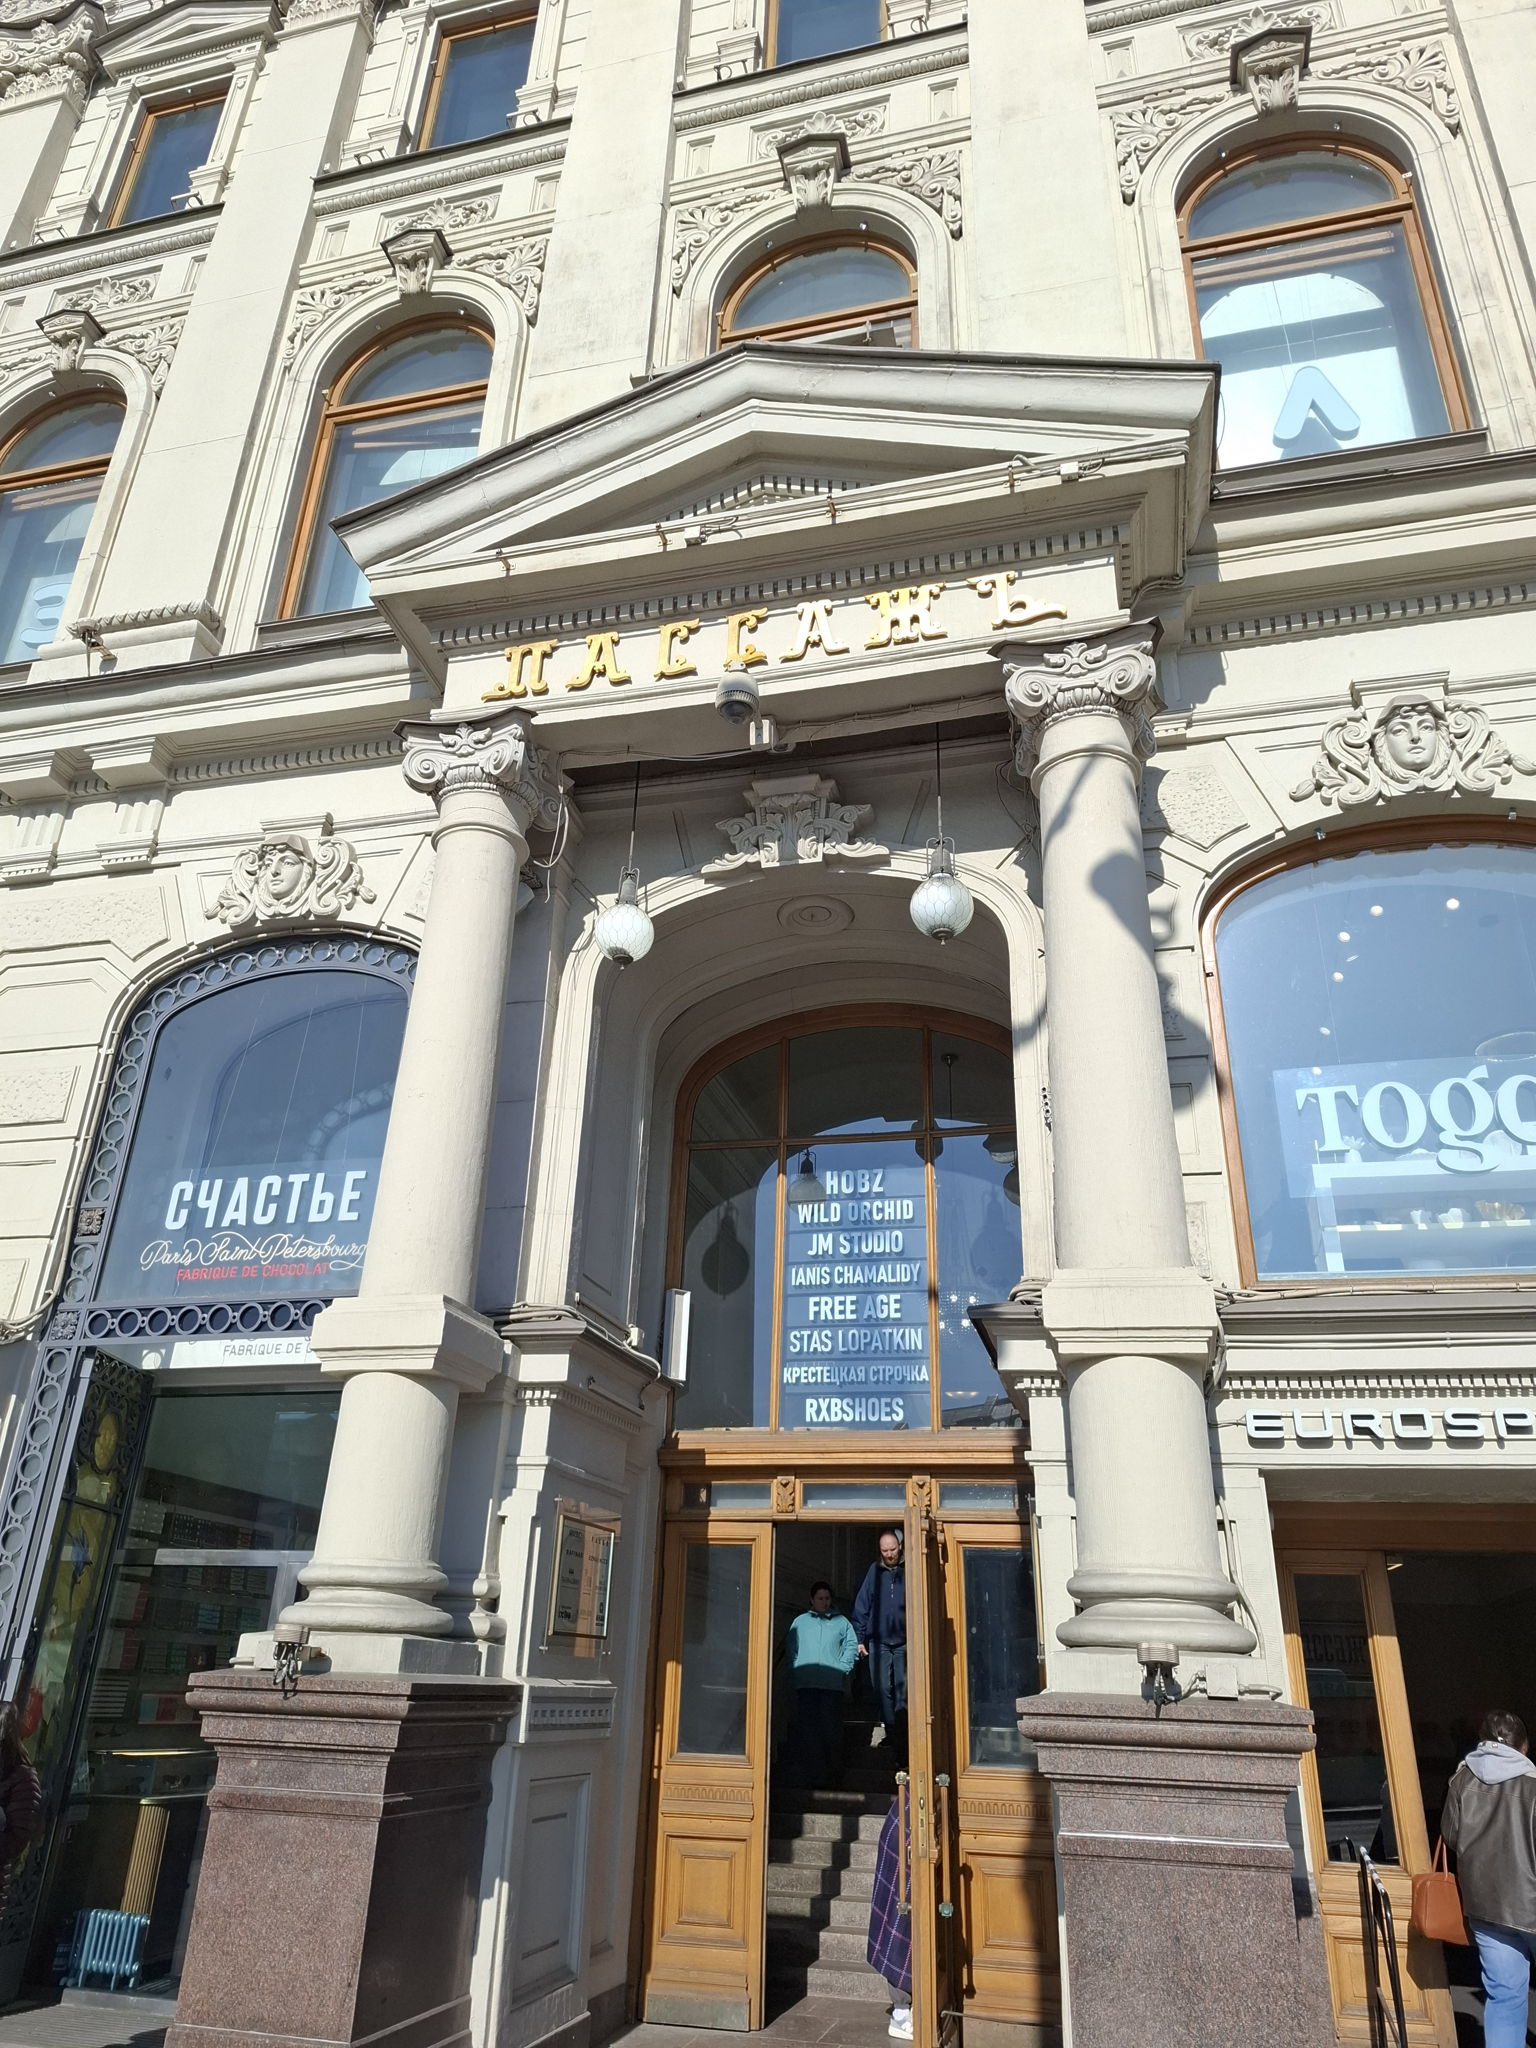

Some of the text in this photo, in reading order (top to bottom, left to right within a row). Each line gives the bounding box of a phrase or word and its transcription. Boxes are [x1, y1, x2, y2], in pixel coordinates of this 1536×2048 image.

[825, 1168, 884, 1195] HOBZ
[165, 1170, 367, 1231] СЧАСТЬЕ
[797, 1199, 914, 1224] WILD ORCHID
[140, 1239, 202, 1271] Paris
[807, 1230, 903, 1256] JM STUDIO
[176, 1262, 329, 1281] FABRIQUE DE CHOCOLAT
[791, 1262, 921, 1286] IANIS CHAMALIDY
[808, 1294, 902, 1320] FREE AGE
[223, 1343, 281, 1356] FABRIQUE
[286, 1342, 303, 1353] DE
[789, 1327, 923, 1353] STAS LOPATKIN
[783, 1365, 930, 1386] КРЕСТЕЦКАЯ СТРОЧКА
[805, 1397, 904, 1423] RXBSHOES
[1245, 1407, 1536, 1440] EUROSP
